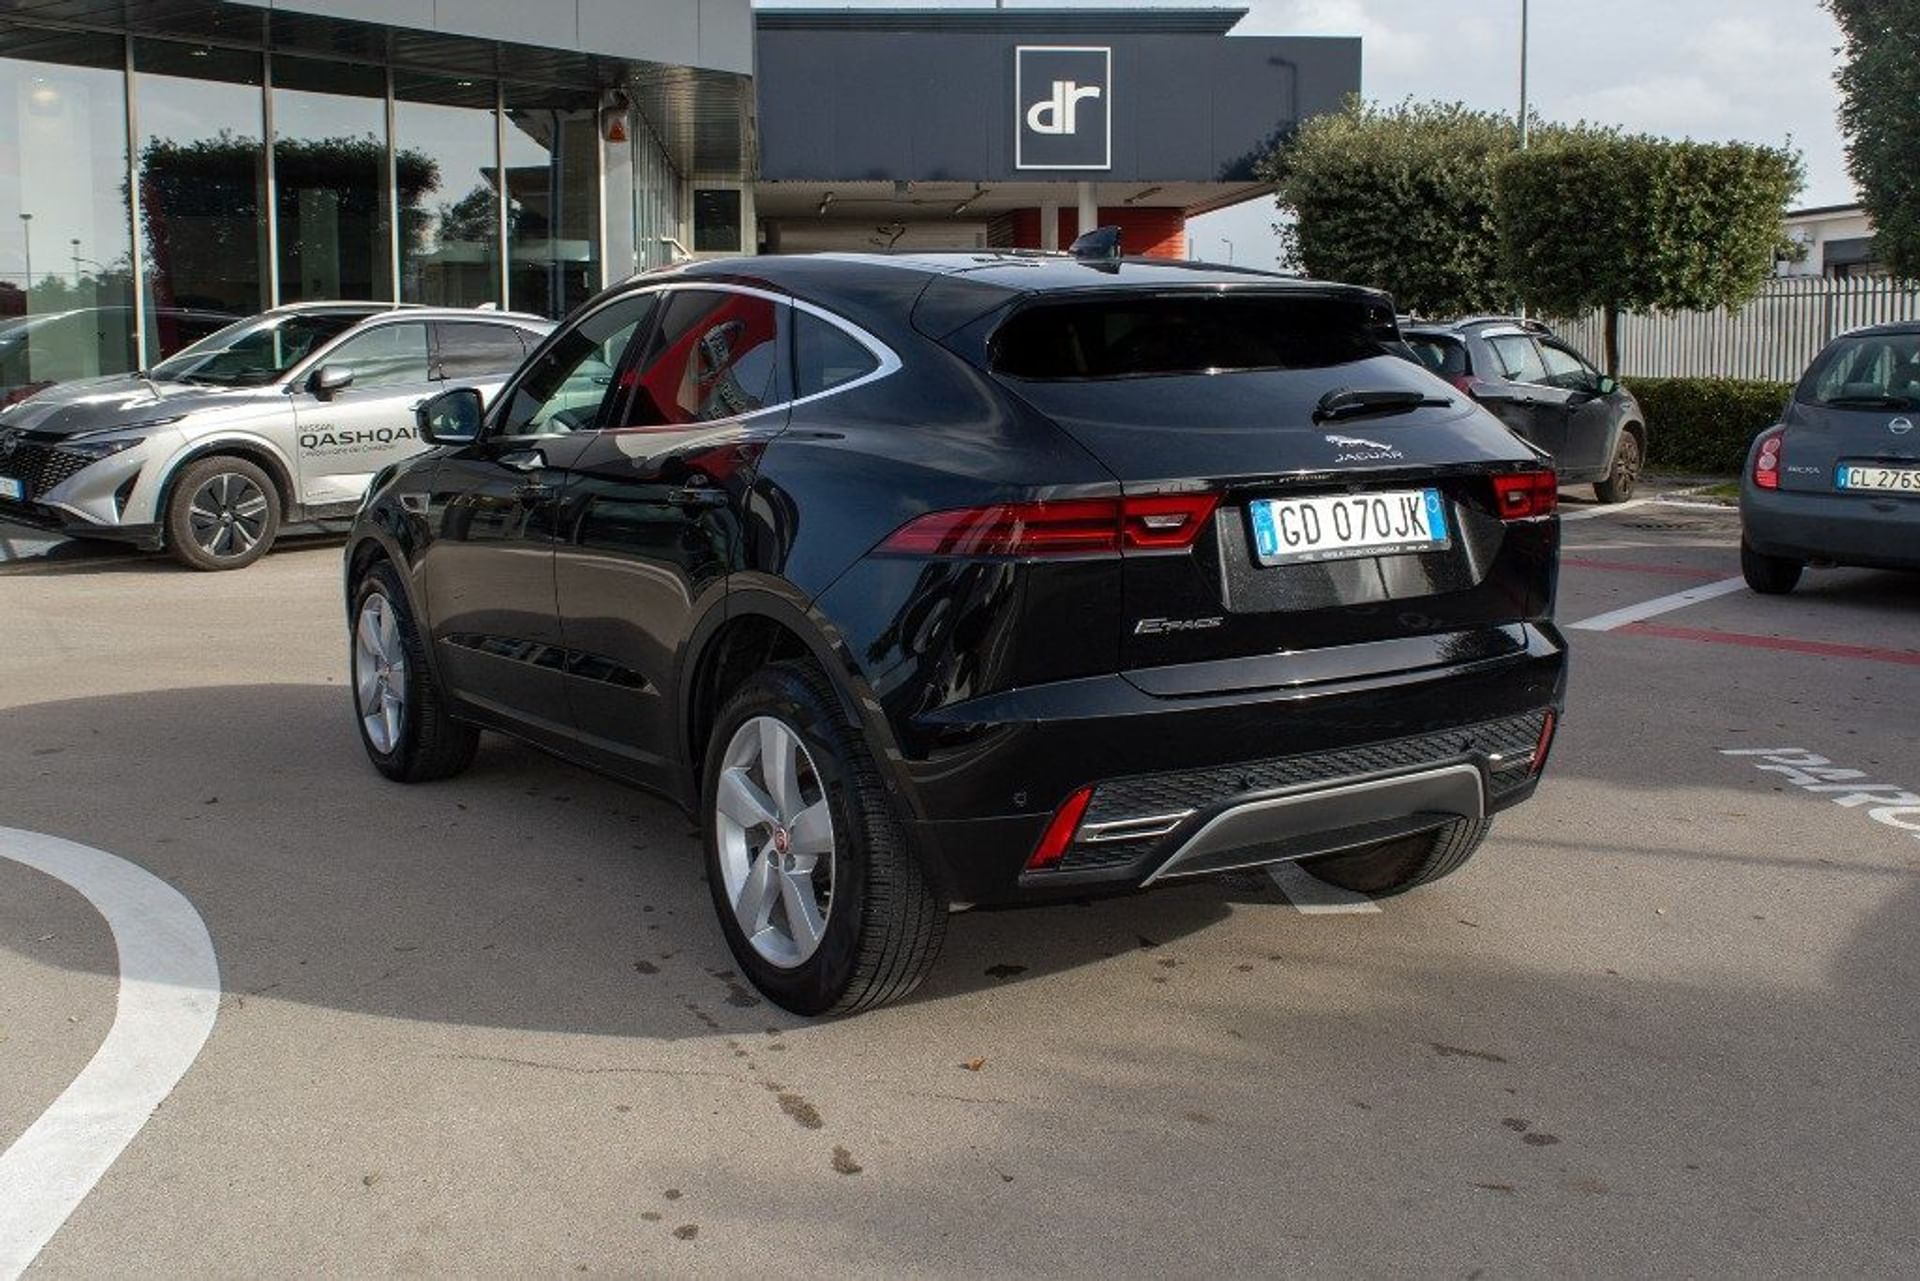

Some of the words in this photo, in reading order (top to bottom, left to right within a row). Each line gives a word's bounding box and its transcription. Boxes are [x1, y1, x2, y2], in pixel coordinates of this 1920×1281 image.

[1027, 81, 1100, 134] dr
[1335, 450, 1403, 462] JAGUAR
[1850, 469, 1871, 487] CL
[1280, 503, 1321, 546] GD
[1332, 496, 1427, 542] 070JK
